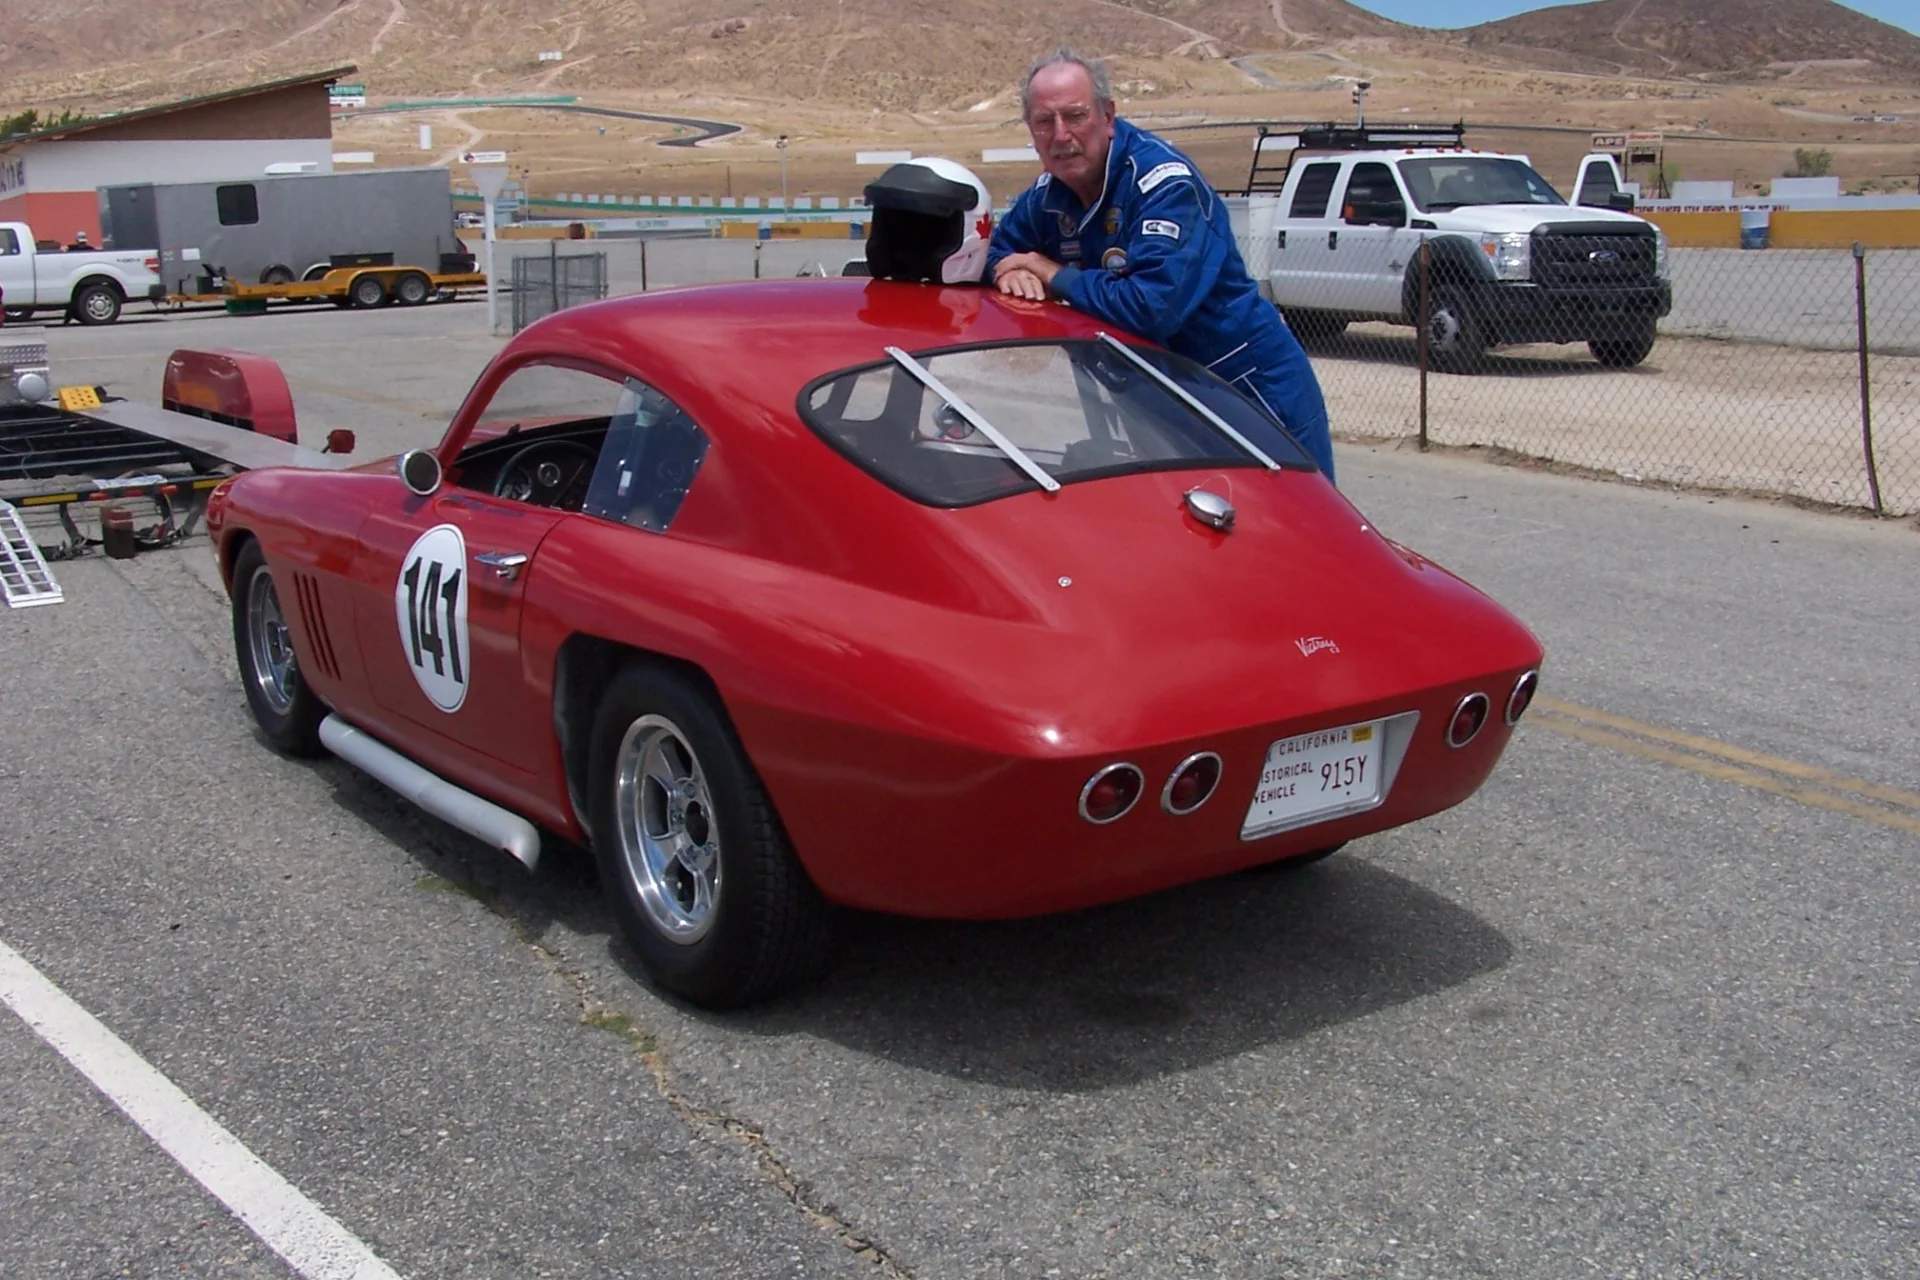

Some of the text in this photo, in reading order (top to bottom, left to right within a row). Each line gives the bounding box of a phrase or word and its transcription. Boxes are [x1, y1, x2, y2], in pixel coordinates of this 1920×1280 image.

[403, 556, 463, 684] 141
[1279, 730, 1348, 756] CALIFORNIA
[1320, 755, 1368, 791] 915Y
